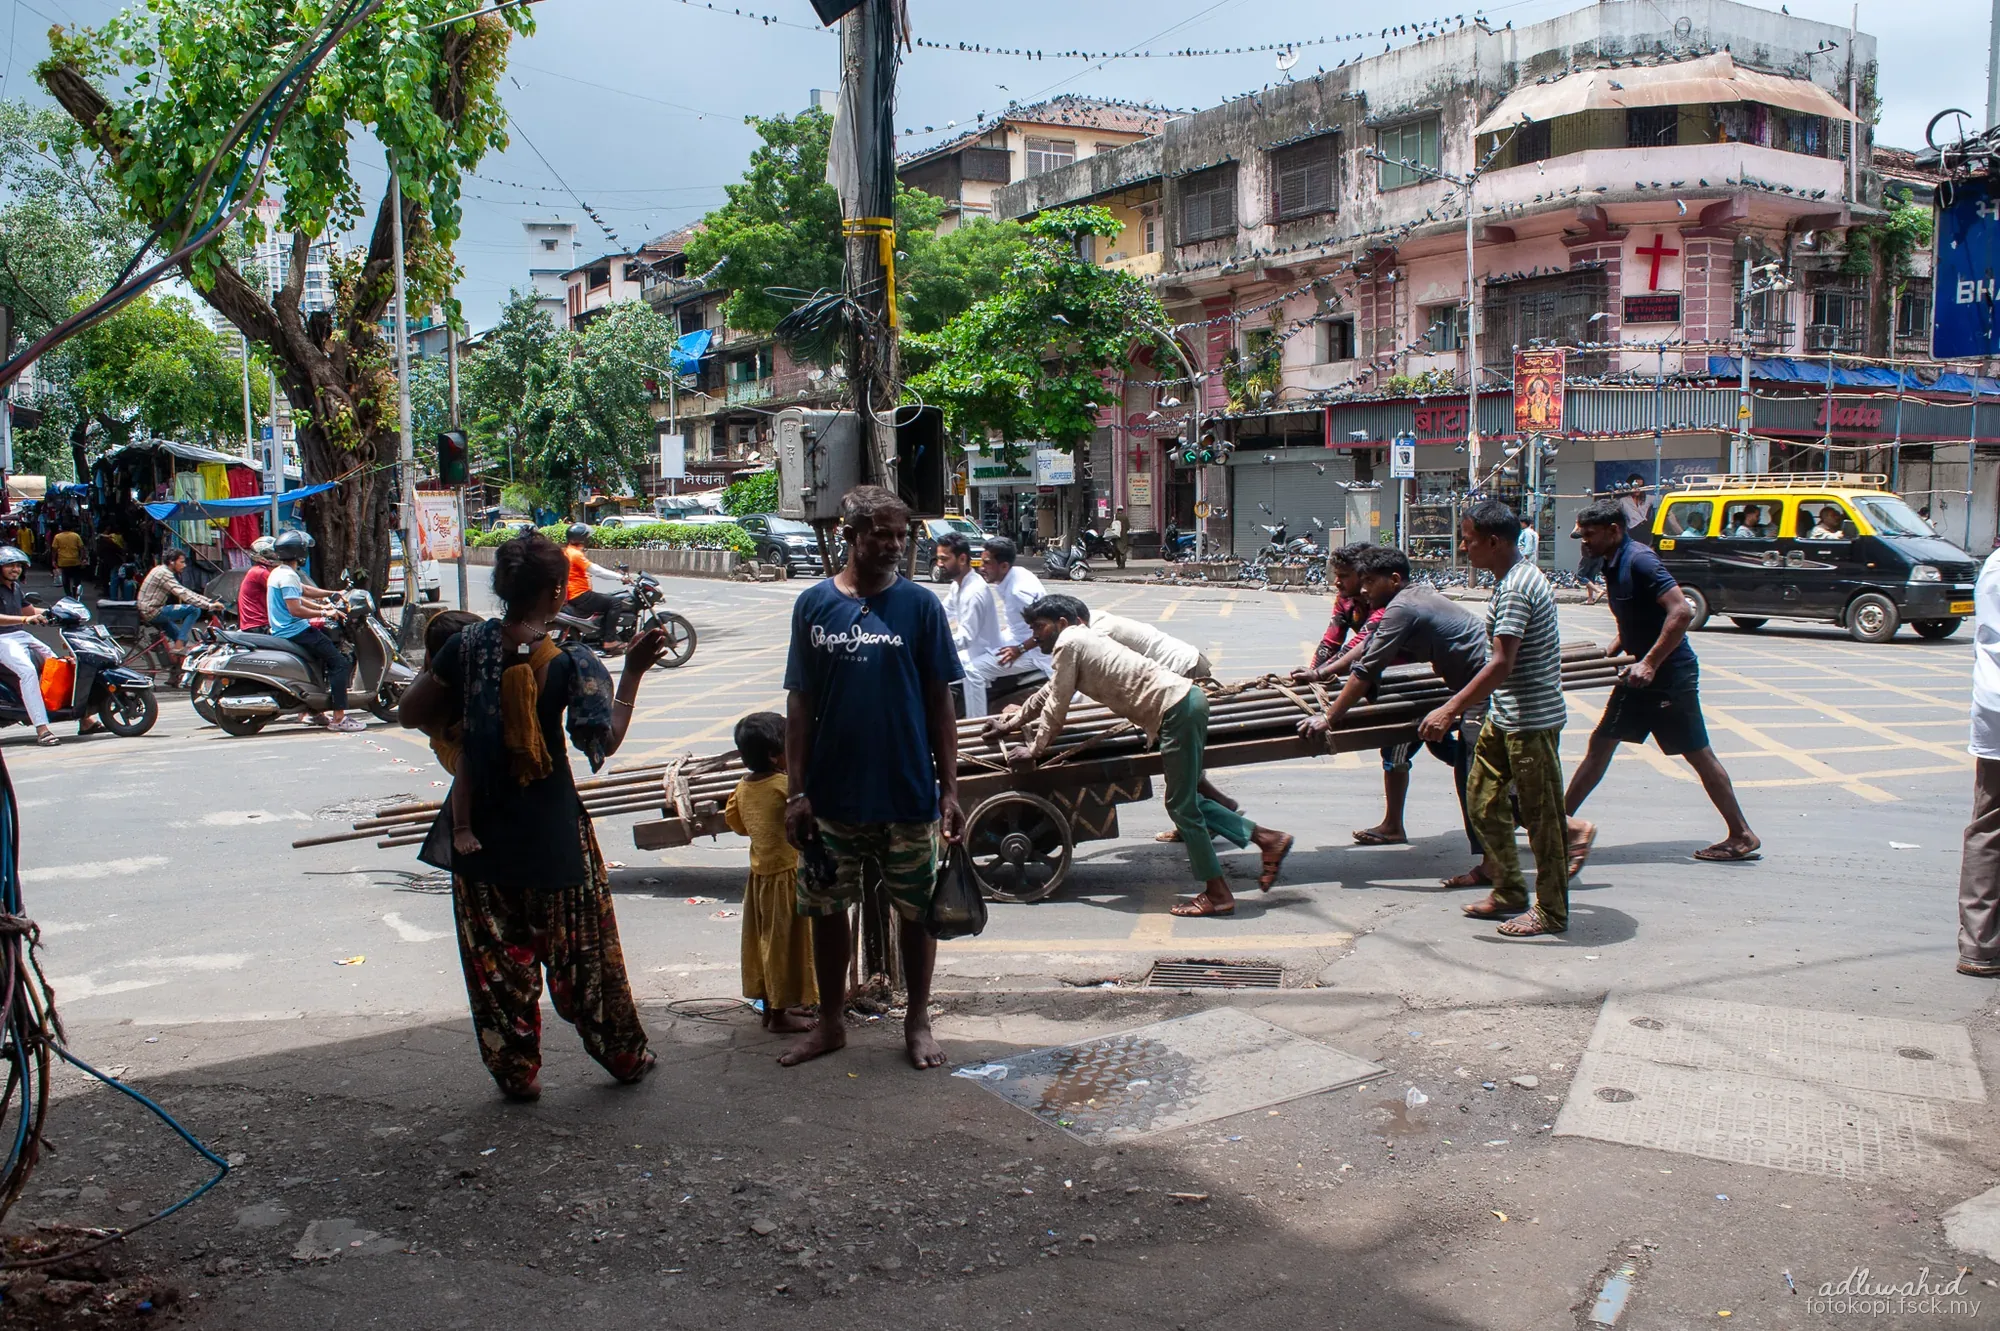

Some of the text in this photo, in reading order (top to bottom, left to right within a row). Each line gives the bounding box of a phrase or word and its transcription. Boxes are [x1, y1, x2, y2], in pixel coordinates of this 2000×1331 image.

[1413, 405, 1468, 433] बाटा
[1817, 399, 1883, 428] Bata
[683, 471, 726, 485] निरवाना
[1671, 464, 1712, 474] Bata
[811, 624, 904, 653] Pepe Jeans
